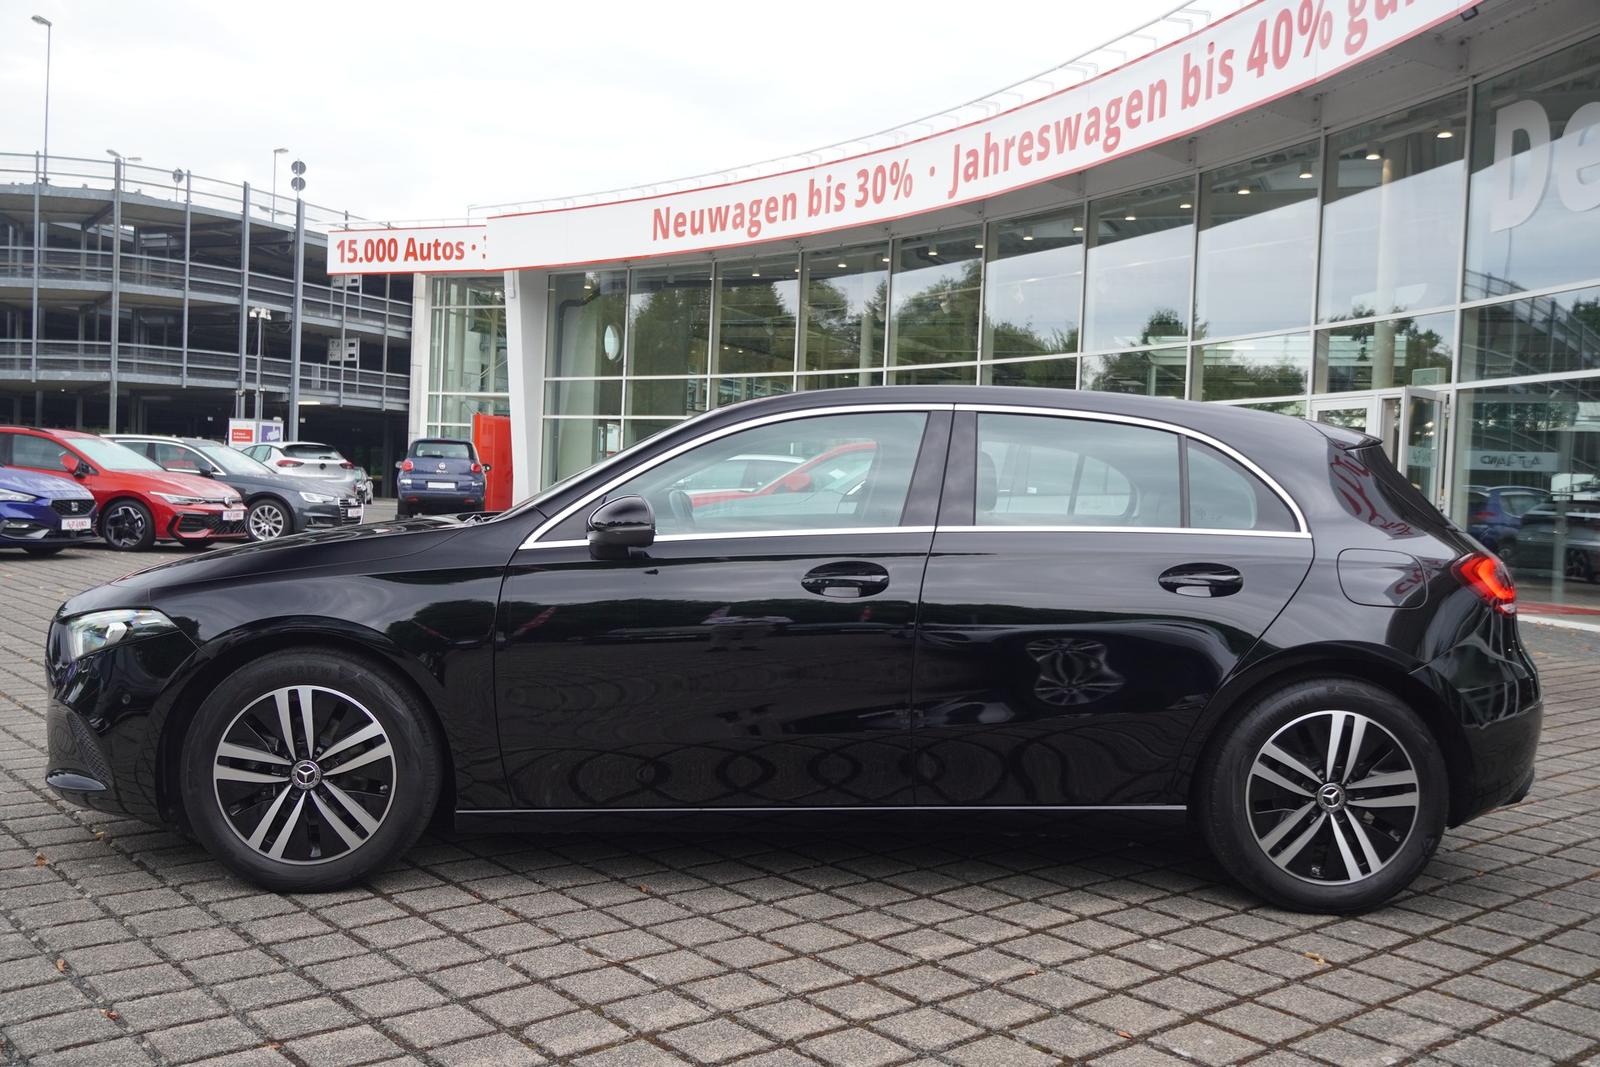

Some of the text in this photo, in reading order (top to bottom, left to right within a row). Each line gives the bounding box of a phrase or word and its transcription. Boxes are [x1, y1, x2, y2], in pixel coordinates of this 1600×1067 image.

[652, 192, 798, 242] Neuwagen
[807, 175, 847, 218] bis
[855, 161, 914, 209] 30%
[947, 79, 1168, 199] Jahreswagen
[1181, 43, 1235, 109] bis
[1246, 0, 1334, 79] 40%
[336, 237, 399, 264] 15.000
[404, 236, 465, 263] Autos
